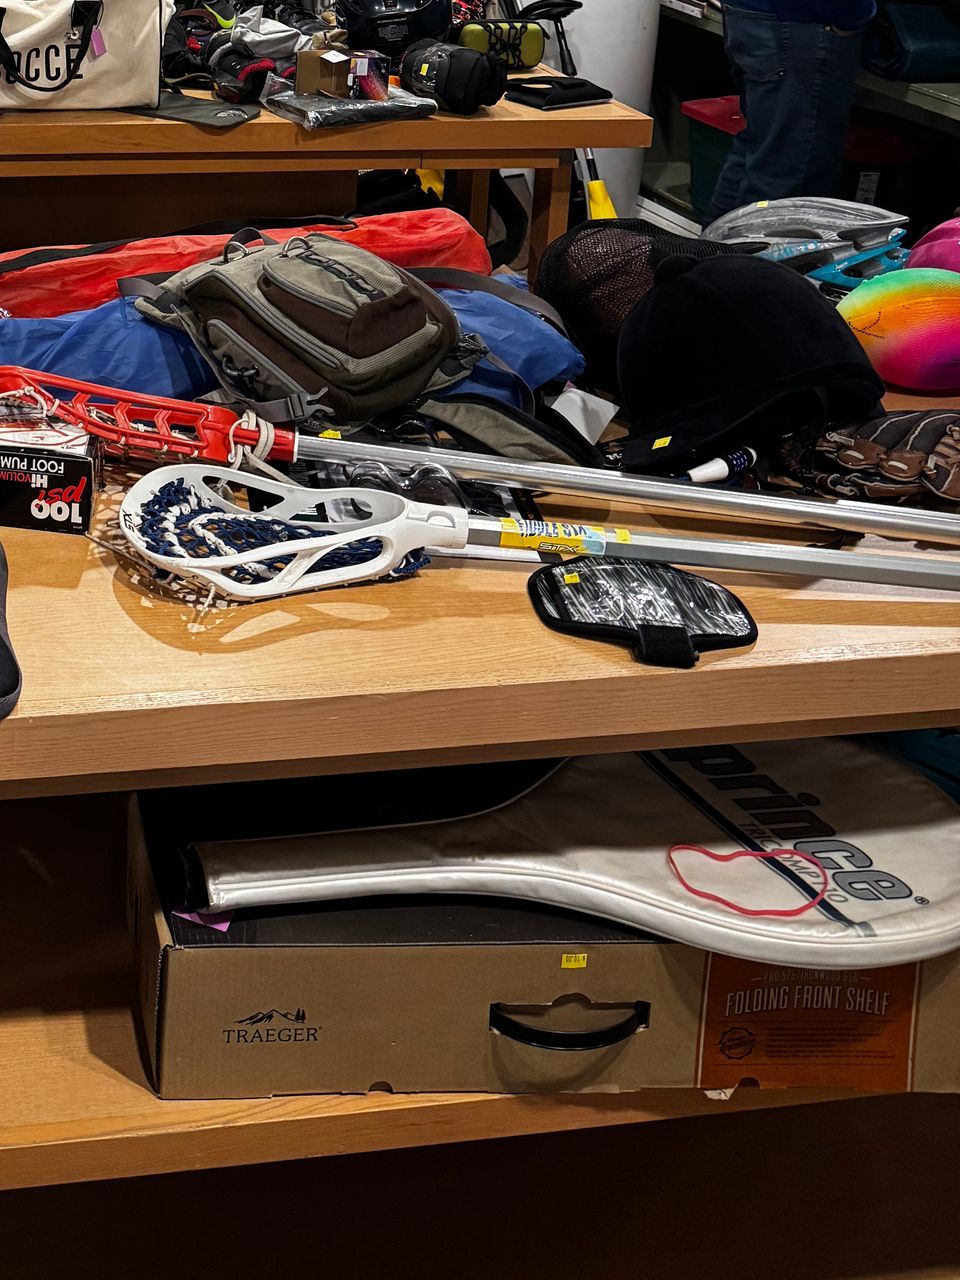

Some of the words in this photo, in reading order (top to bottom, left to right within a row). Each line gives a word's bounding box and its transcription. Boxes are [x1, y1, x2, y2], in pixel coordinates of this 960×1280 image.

[30, 458, 64, 473] FOOT
[30, 500, 83, 524] 100
[539, 542, 580, 553] STX
[725, 986, 788, 1017] FOLDING
[794, 985, 842, 1009] FRONT
[846, 987, 891, 1016] SHELF
[222, 1028, 319, 1044] TRAEGER
